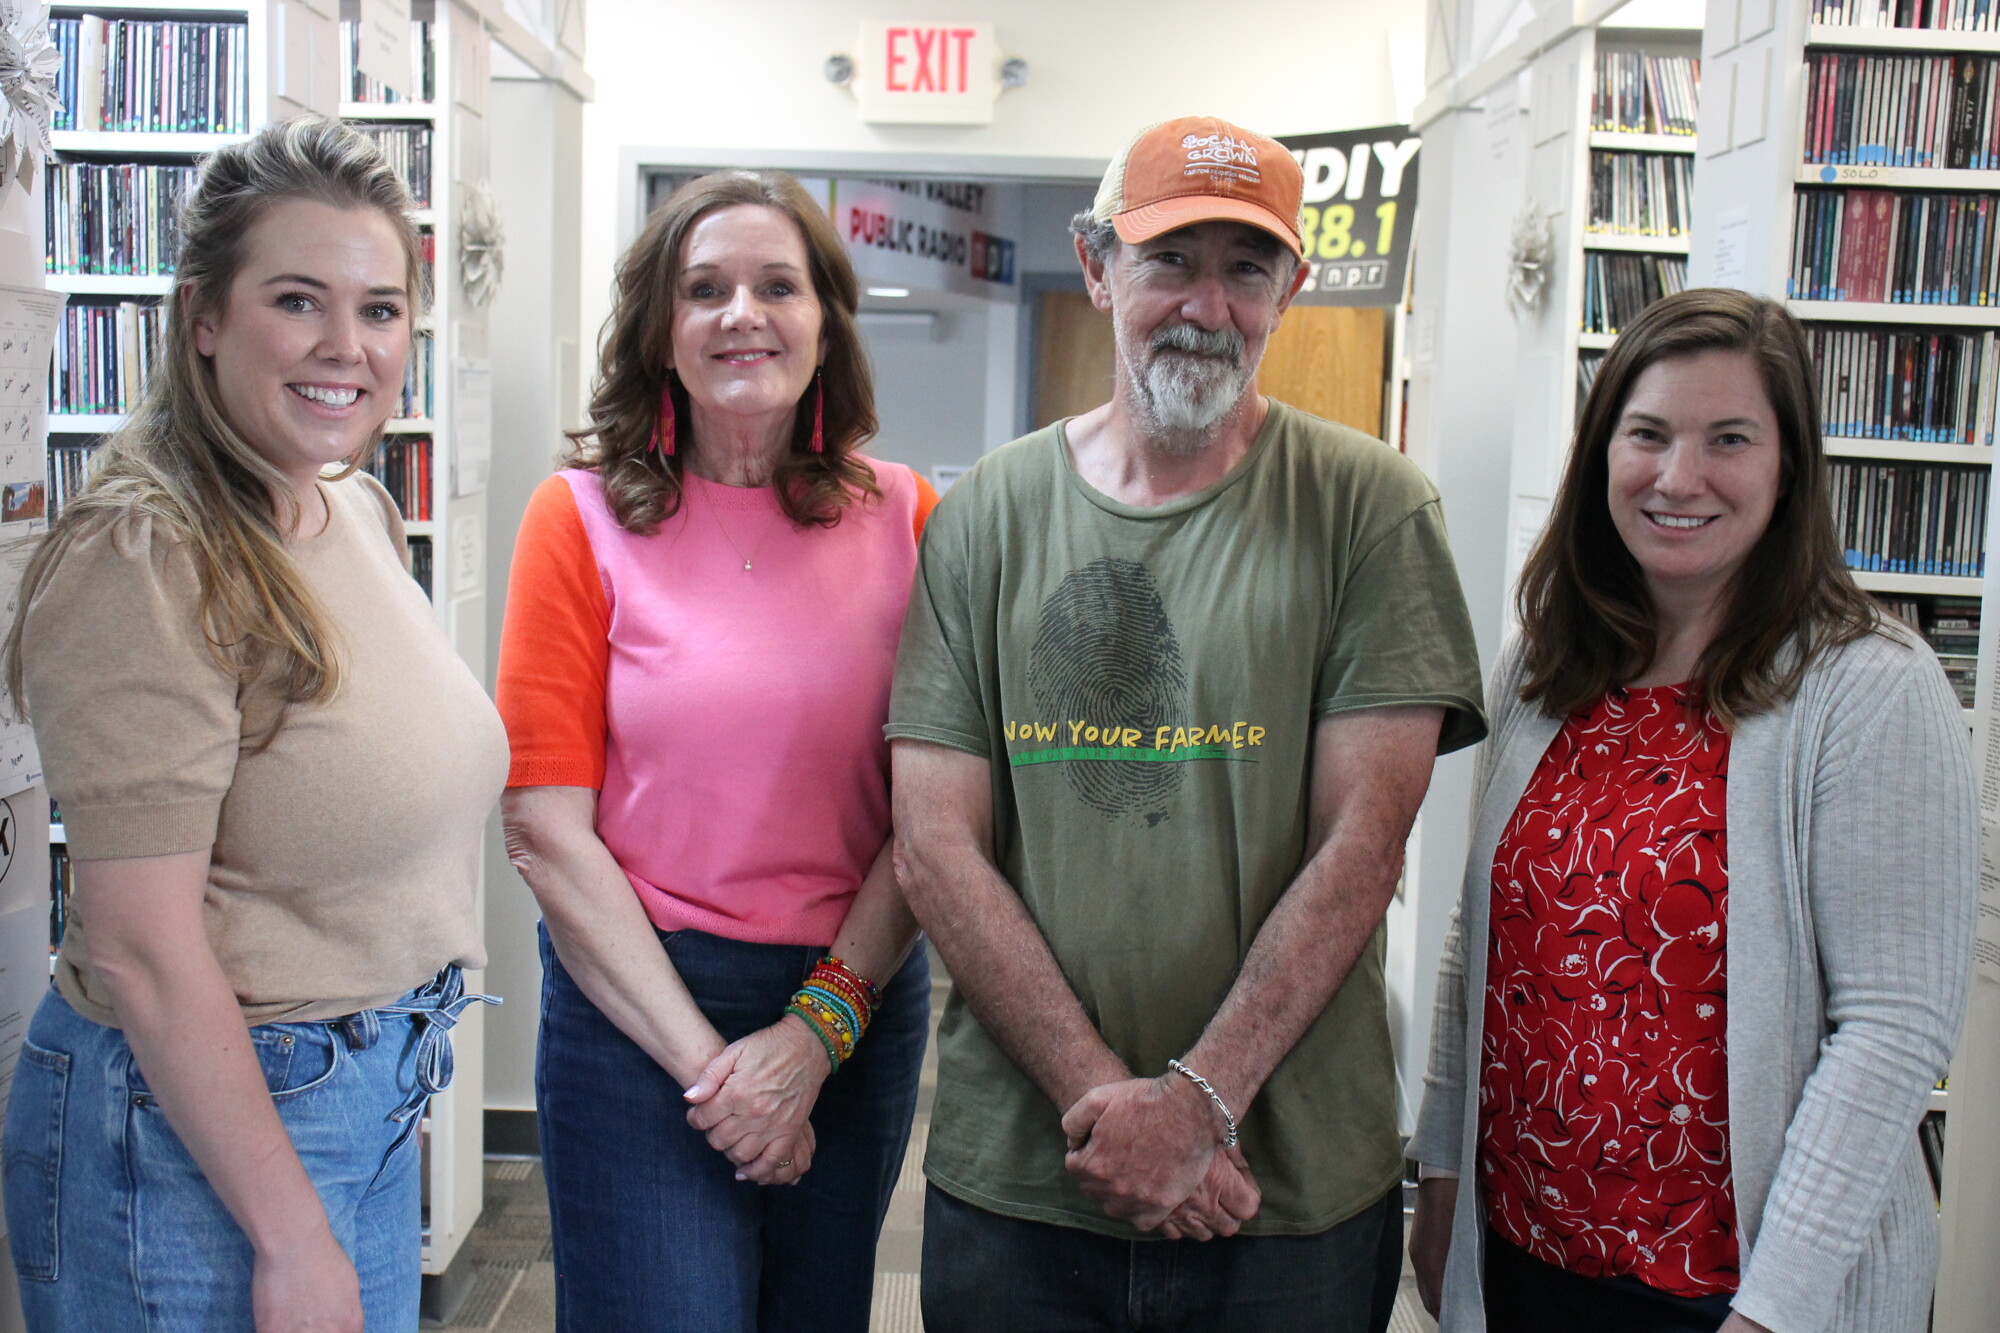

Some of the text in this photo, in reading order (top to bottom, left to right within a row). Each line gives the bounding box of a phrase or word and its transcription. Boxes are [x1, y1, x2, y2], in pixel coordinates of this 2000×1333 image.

[887, 28, 976, 93] EXIT
[1187, 147, 1257, 167] GROWN
[1290, 138, 1423, 203] DIY
[1842, 168, 1878, 179] SOLO
[850, 206, 968, 267] PUBLIC RADIO
[1327, 265, 1381, 289] npr
[1003, 720, 1266, 753] NOW YOUR FARMER
